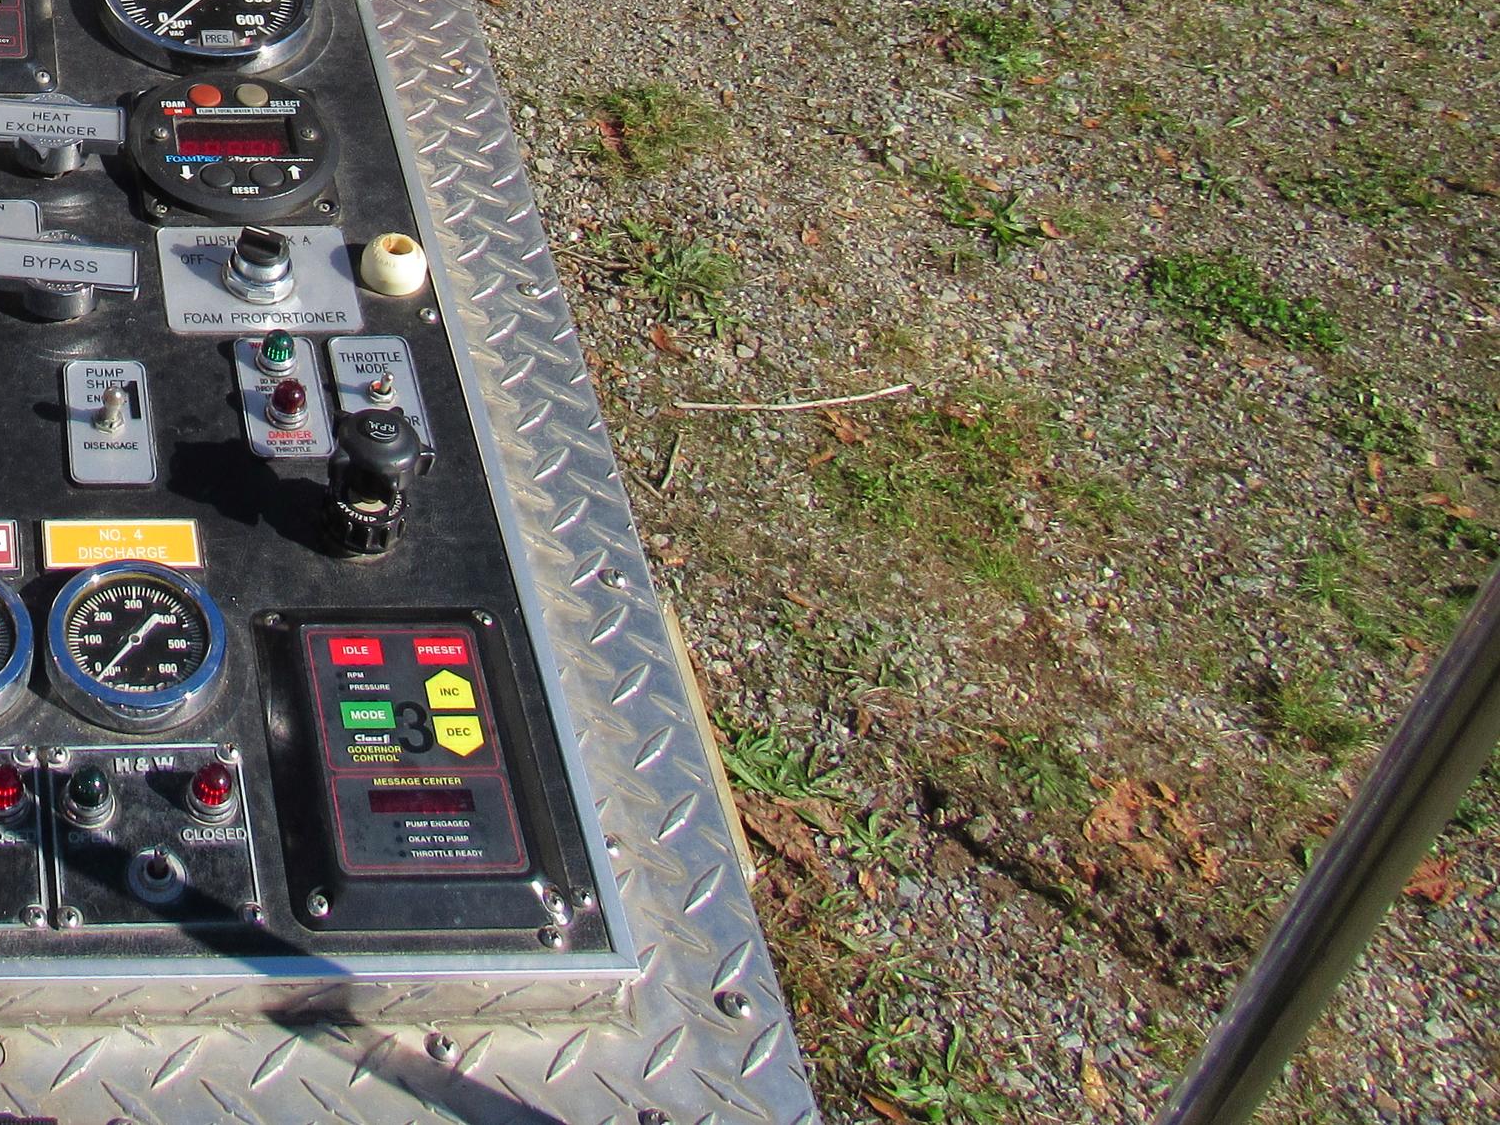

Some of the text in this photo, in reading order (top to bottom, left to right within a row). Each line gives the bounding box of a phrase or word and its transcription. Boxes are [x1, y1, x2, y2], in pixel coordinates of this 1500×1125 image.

[236, 14, 265, 26] 600
[204, 33, 232, 44] PRES.
[160, 100, 186, 108] FOAM
[269, 100, 301, 108] SELECT
[32, 111, 71, 123] HEAT
[5, 121, 97, 137] EXCHANGER
[231, 186, 260, 195] RESET
[196, 236, 236, 246] FLUSH
[302, 236, 312, 246] A
[22, 255, 99, 274] BYPASS
[180, 254, 205, 265] OFF
[183, 312, 347, 324] FOAM PROPORTIONER
[338, 351, 402, 363] THROTTLE
[85, 368, 124, 378] PUMP
[355, 363, 389, 374] MODE
[268, 431, 313, 439] DANGER
[83, 441, 139, 450] DISENGAGE
[99, 529, 143, 541] NO. 4
[78, 546, 169, 559] DISCHARGE
[124, 600, 143, 610] 300
[93, 611, 113, 622] 200
[83, 634, 102, 645] 100
[167, 639, 187, 650] 500
[342, 645, 369, 655] IDLE
[417, 645, 463, 655] PRESET
[158, 663, 178, 674] 600
[439, 687, 460, 697] INC
[350, 710, 386, 720] MODE
[395, 700, 435, 754] 3
[446, 727, 472, 737] DEC
[347, 745, 402, 754] GOVERNOR
[352, 754, 400, 762] CONTROL
[373, 777, 462, 786] MESSAGE CENTER
[405, 820, 470, 828] PUMP ENGAGED
[67, 830, 114, 844] OPEN
[181, 827, 247, 842] CLOSED
[408, 835, 469, 843] OKAY TO PUMP
[411, 850, 483, 858] THROTTLE READY
